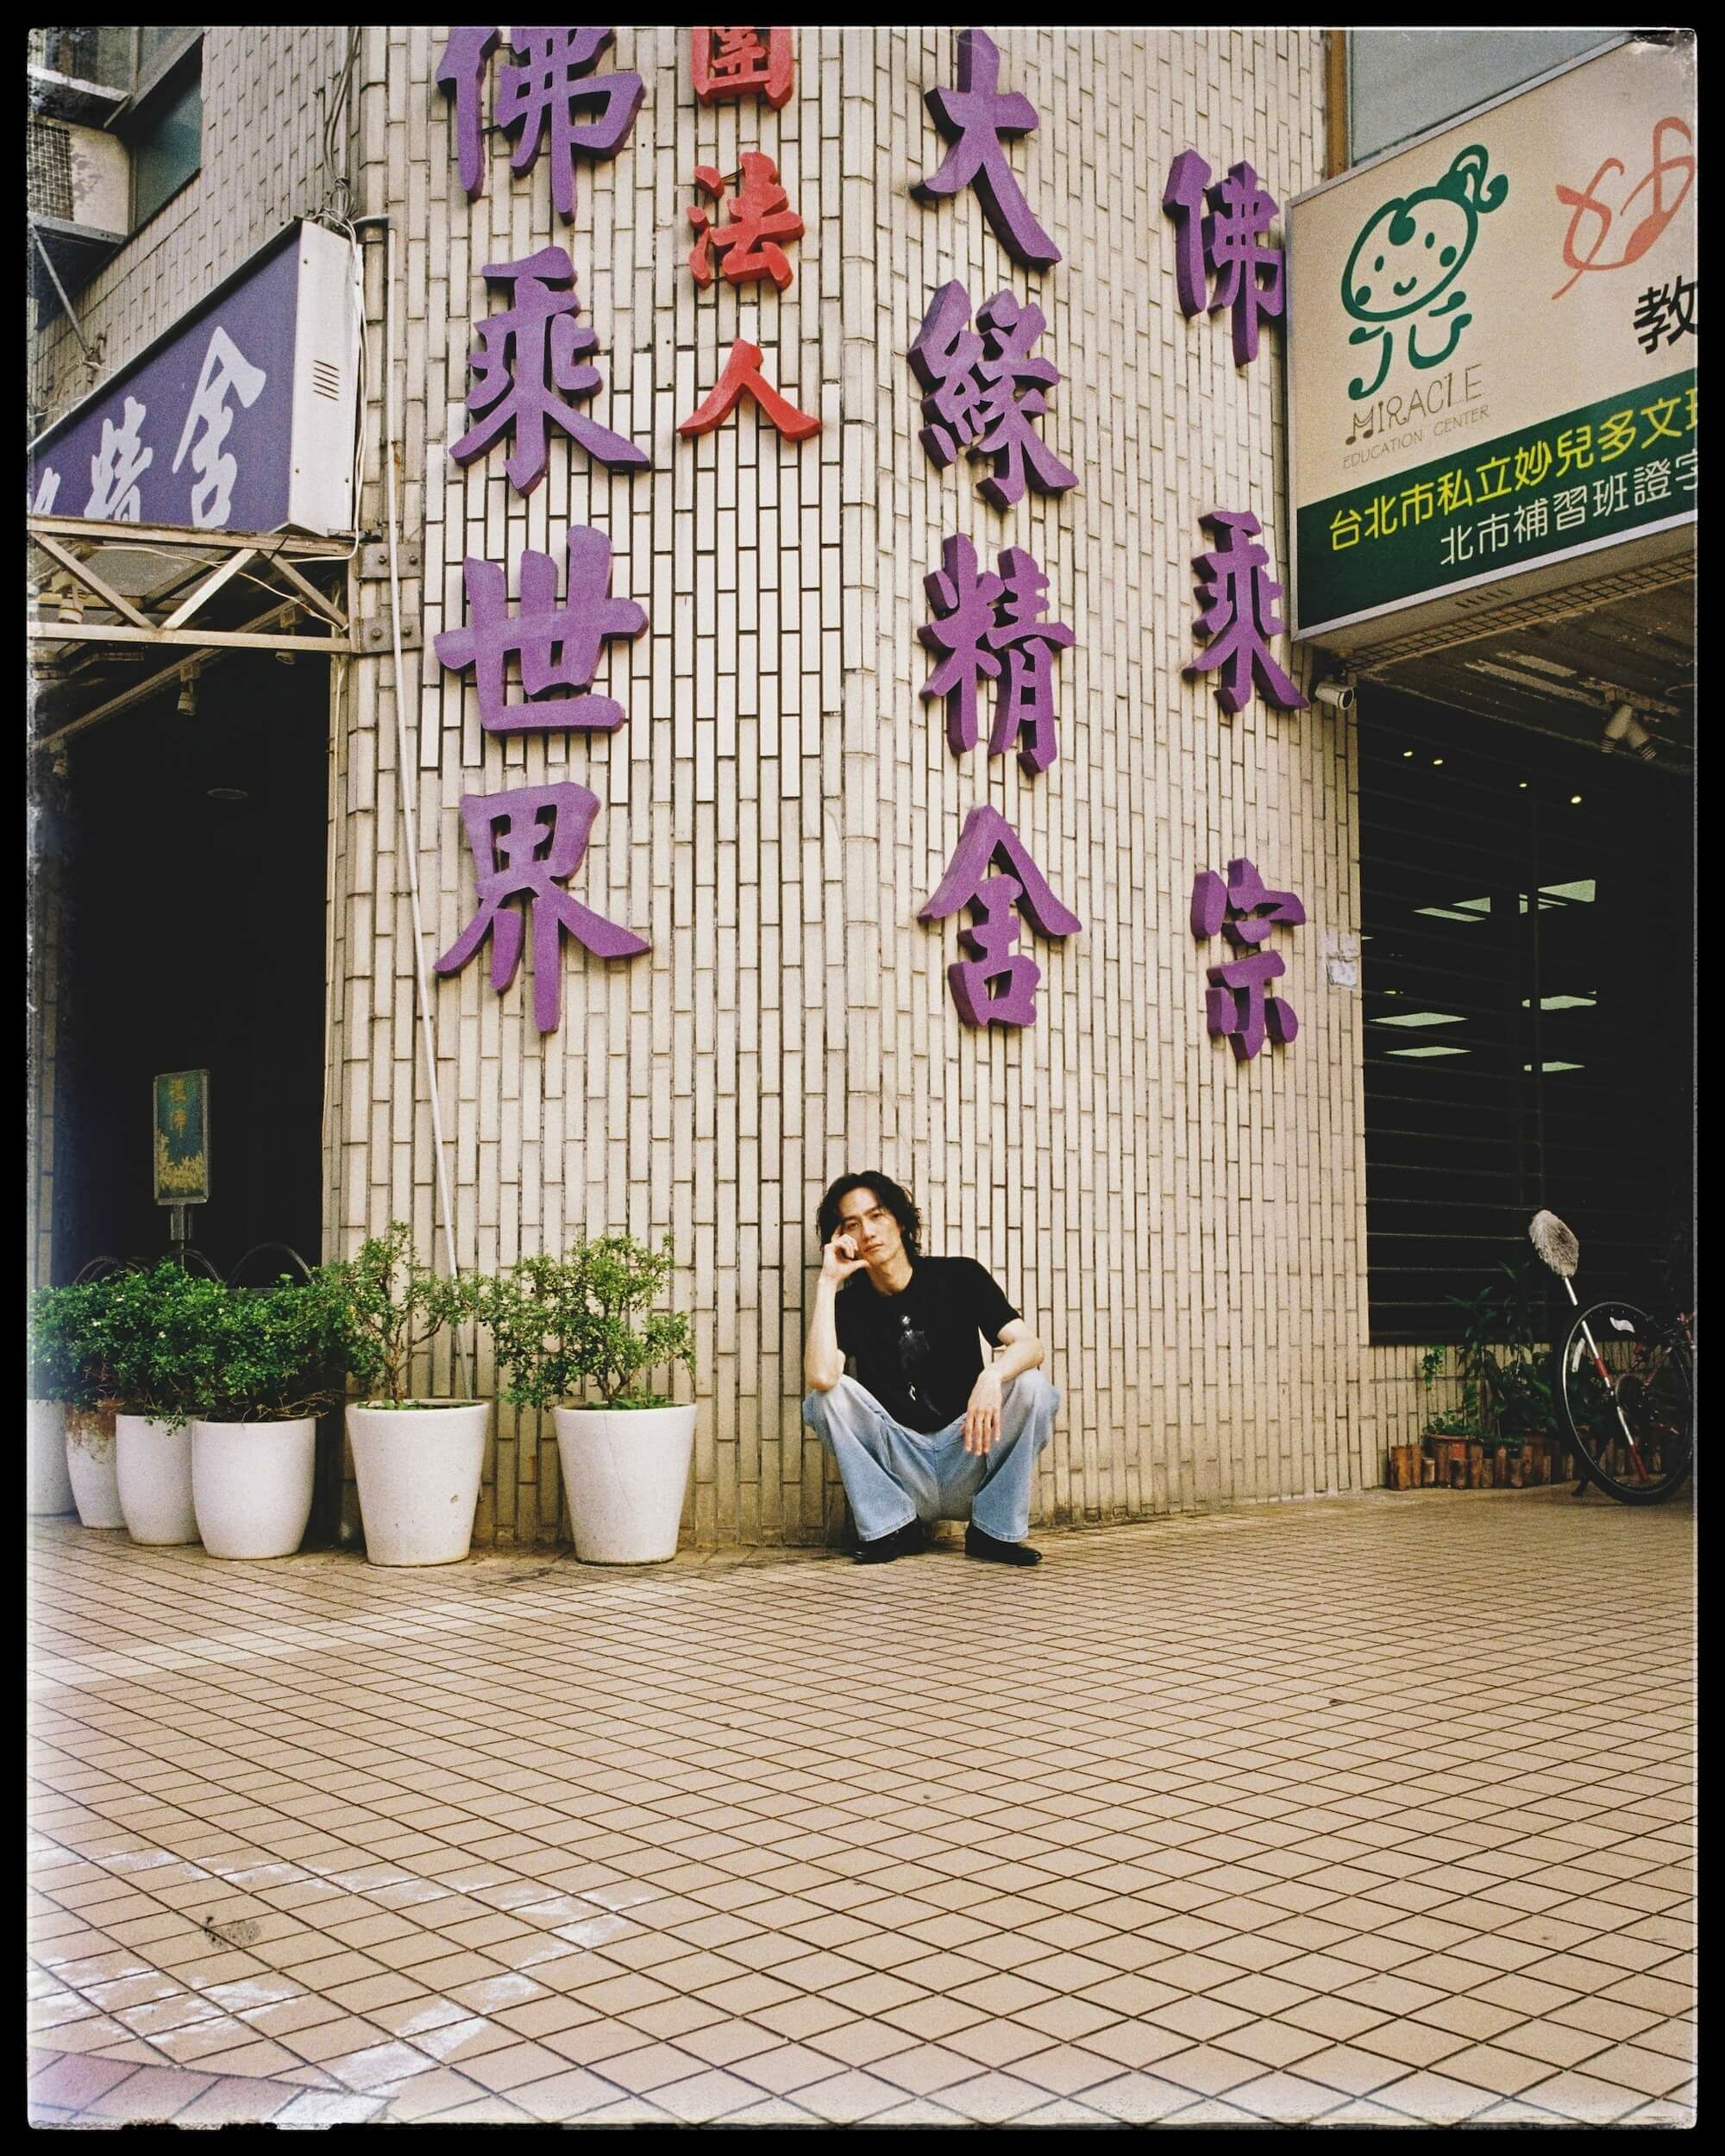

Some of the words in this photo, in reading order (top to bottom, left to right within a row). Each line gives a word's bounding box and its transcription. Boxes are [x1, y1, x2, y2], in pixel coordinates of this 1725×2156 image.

[433, 27, 652, 1033] 佛乘世界
[908, 28, 1082, 1028] 大緣精舍
[1163, 149, 1309, 1061] 佛乘宗
[1342, 432, 1423, 470] EDUCATION
[1433, 404, 1490, 437] CENTER
[1346, 364, 1483, 446] MIRACLE
